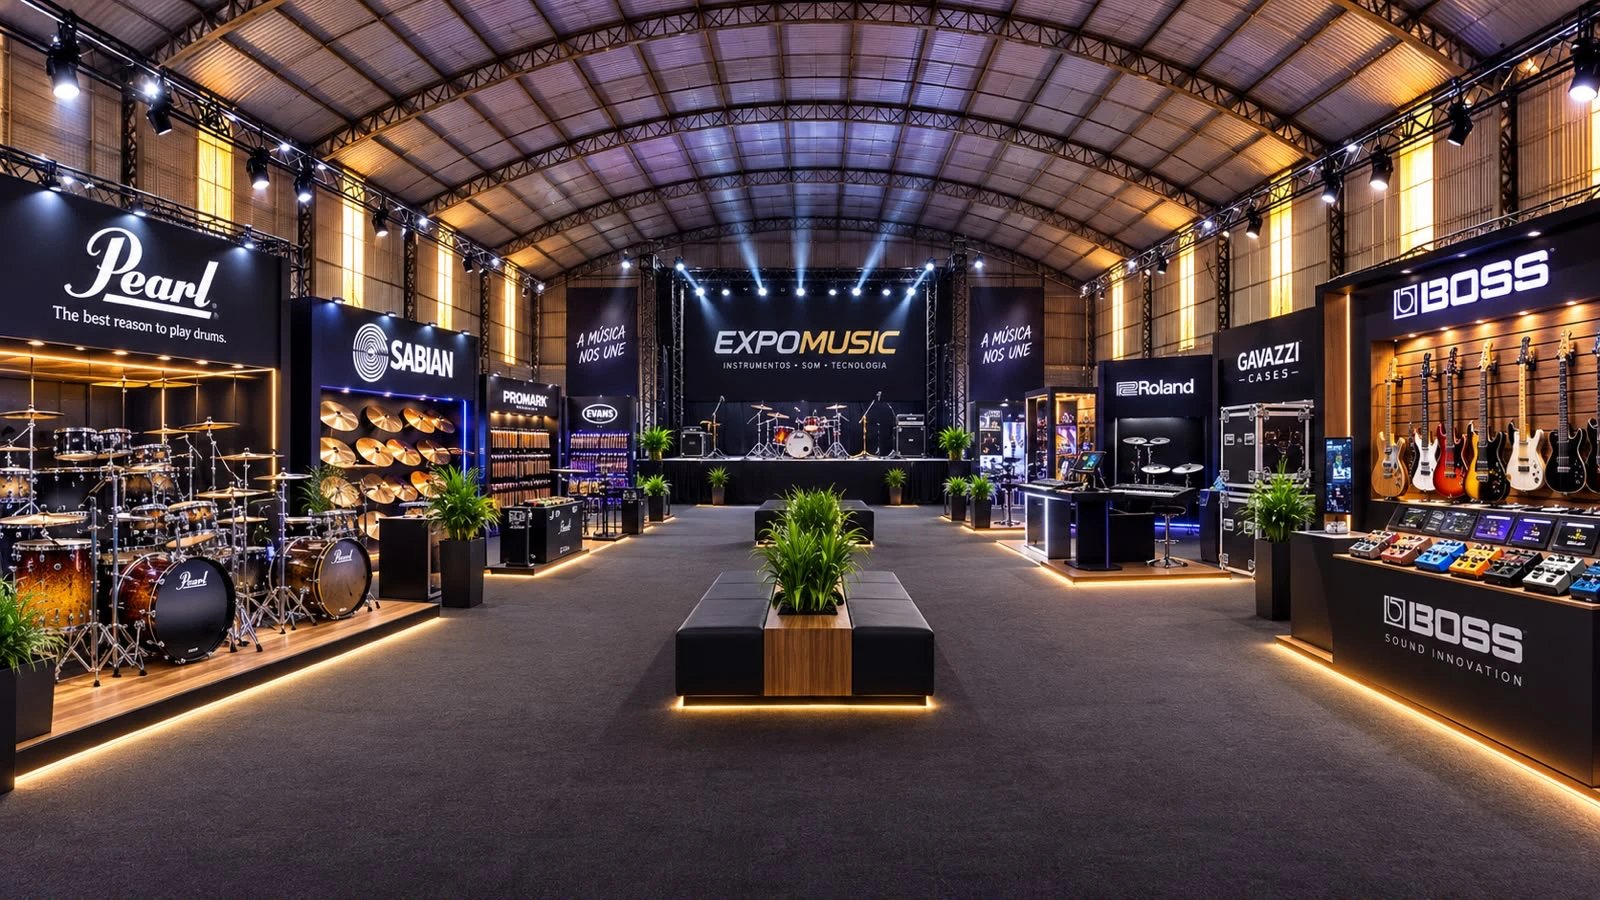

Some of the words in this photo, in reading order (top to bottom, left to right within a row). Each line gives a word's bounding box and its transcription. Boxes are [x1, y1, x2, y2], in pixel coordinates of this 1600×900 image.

[64, 227, 219, 308] Pearl
[1421, 249, 1549, 314] BOSS
[53, 305, 79, 322] The
[83, 309, 111, 327] best
[114, 316, 153, 333] reason
[156, 322, 167, 335] to
[169, 324, 192, 340] play
[194, 327, 227, 344] drums.
[576, 332, 585, 349] A
[588, 325, 627, 346] MÚSICA
[714, 330, 900, 354] EXPOMUSIC
[980, 332, 989, 349] A
[992, 325, 1032, 346] MÚSICA
[390, 339, 454, 379] SABIAN
[579, 347, 600, 364] NOS
[603, 341, 627, 359] UNE
[983, 347, 1005, 364] NOS
[1009, 341, 1032, 359] UNE
[1237, 341, 1300, 371] GAVAZZI
[723, 361, 791, 370] INSTRUMENTOS
[802, 361, 821, 370] SOM
[831, 361, 888, 370] TECNOLOGIA
[1248, 368, 1289, 383] CASES
[503, 390, 548, 408] PROMARK
[1138, 378, 1194, 396] Roland
[586, 409, 614, 418] EVANS
[176, 570, 209, 590] Pearl
[1409, 601, 1523, 664] BOSS
[1385, 633, 1425, 655] SOUND
[1432, 648, 1522, 687] INNOVATION
